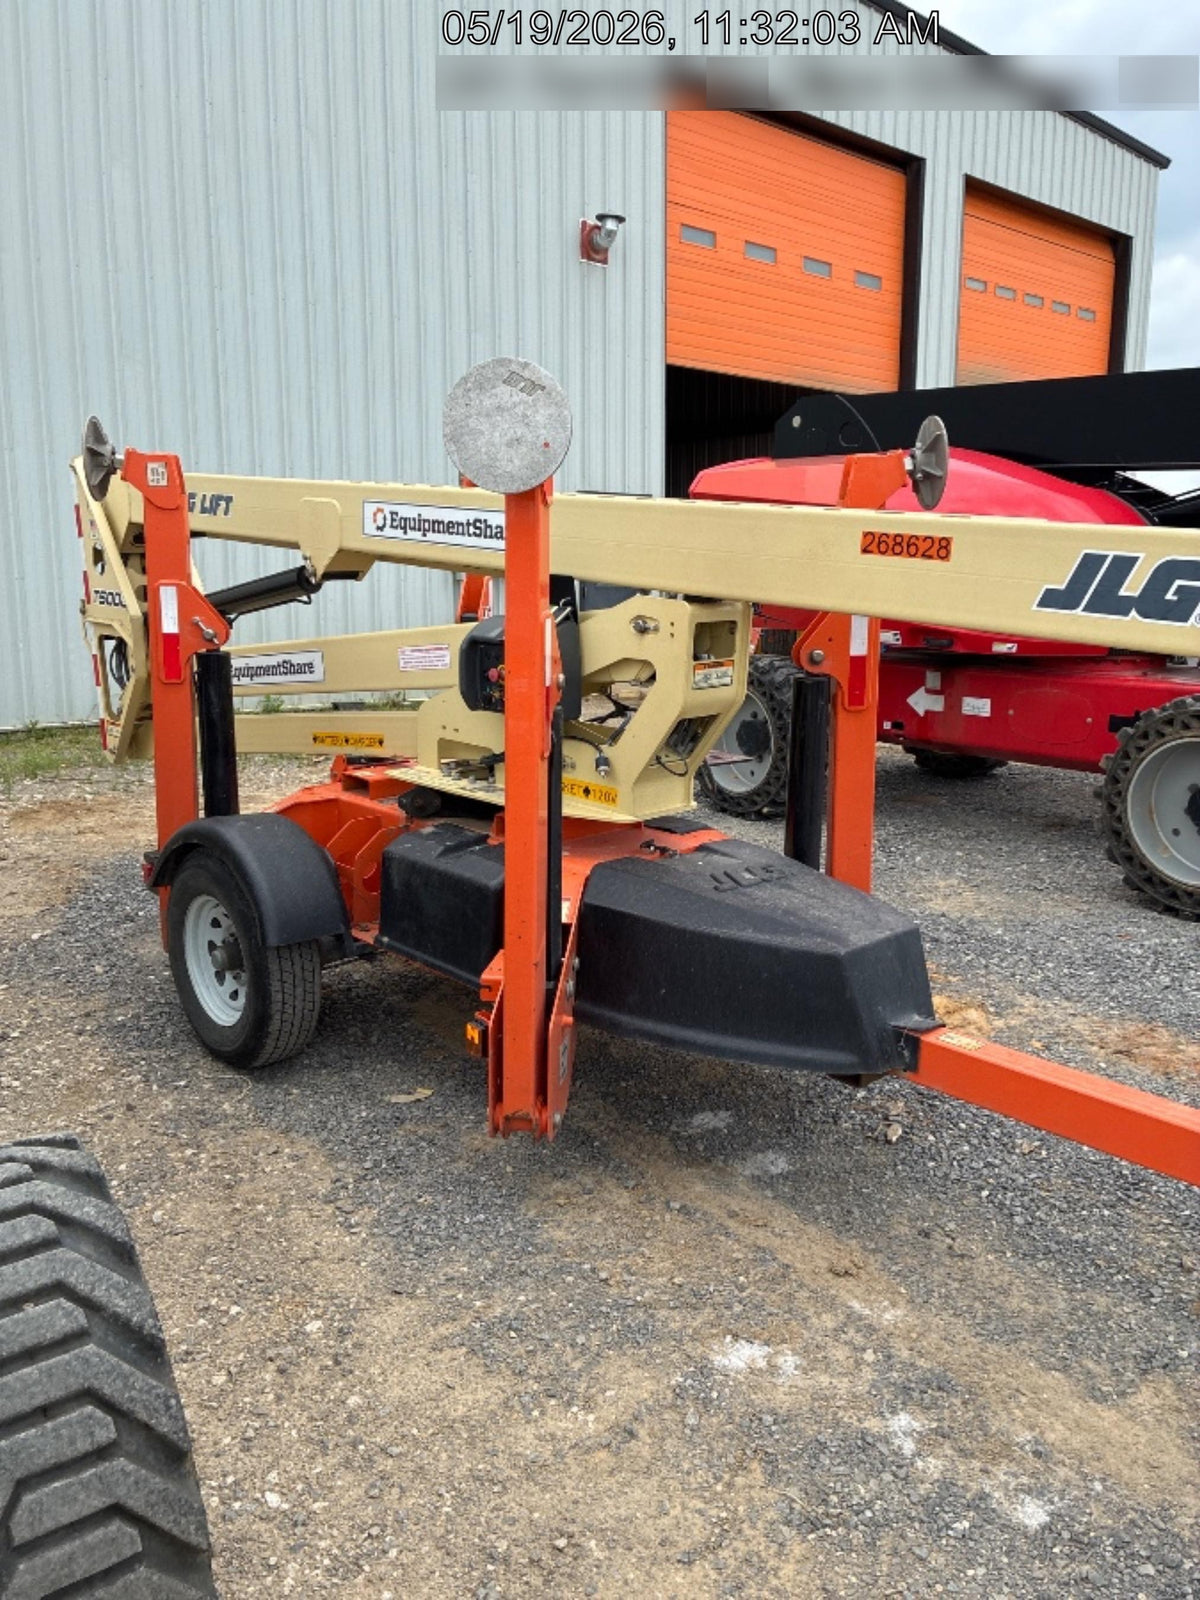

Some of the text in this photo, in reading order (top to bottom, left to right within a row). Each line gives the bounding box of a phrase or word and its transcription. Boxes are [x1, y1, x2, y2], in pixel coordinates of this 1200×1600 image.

[200, 493, 234, 517] LIFT
[389, 510, 505, 541] EquipmentSha
[862, 531, 950, 560] 268628
[1034, 550, 1200, 626] JLG
